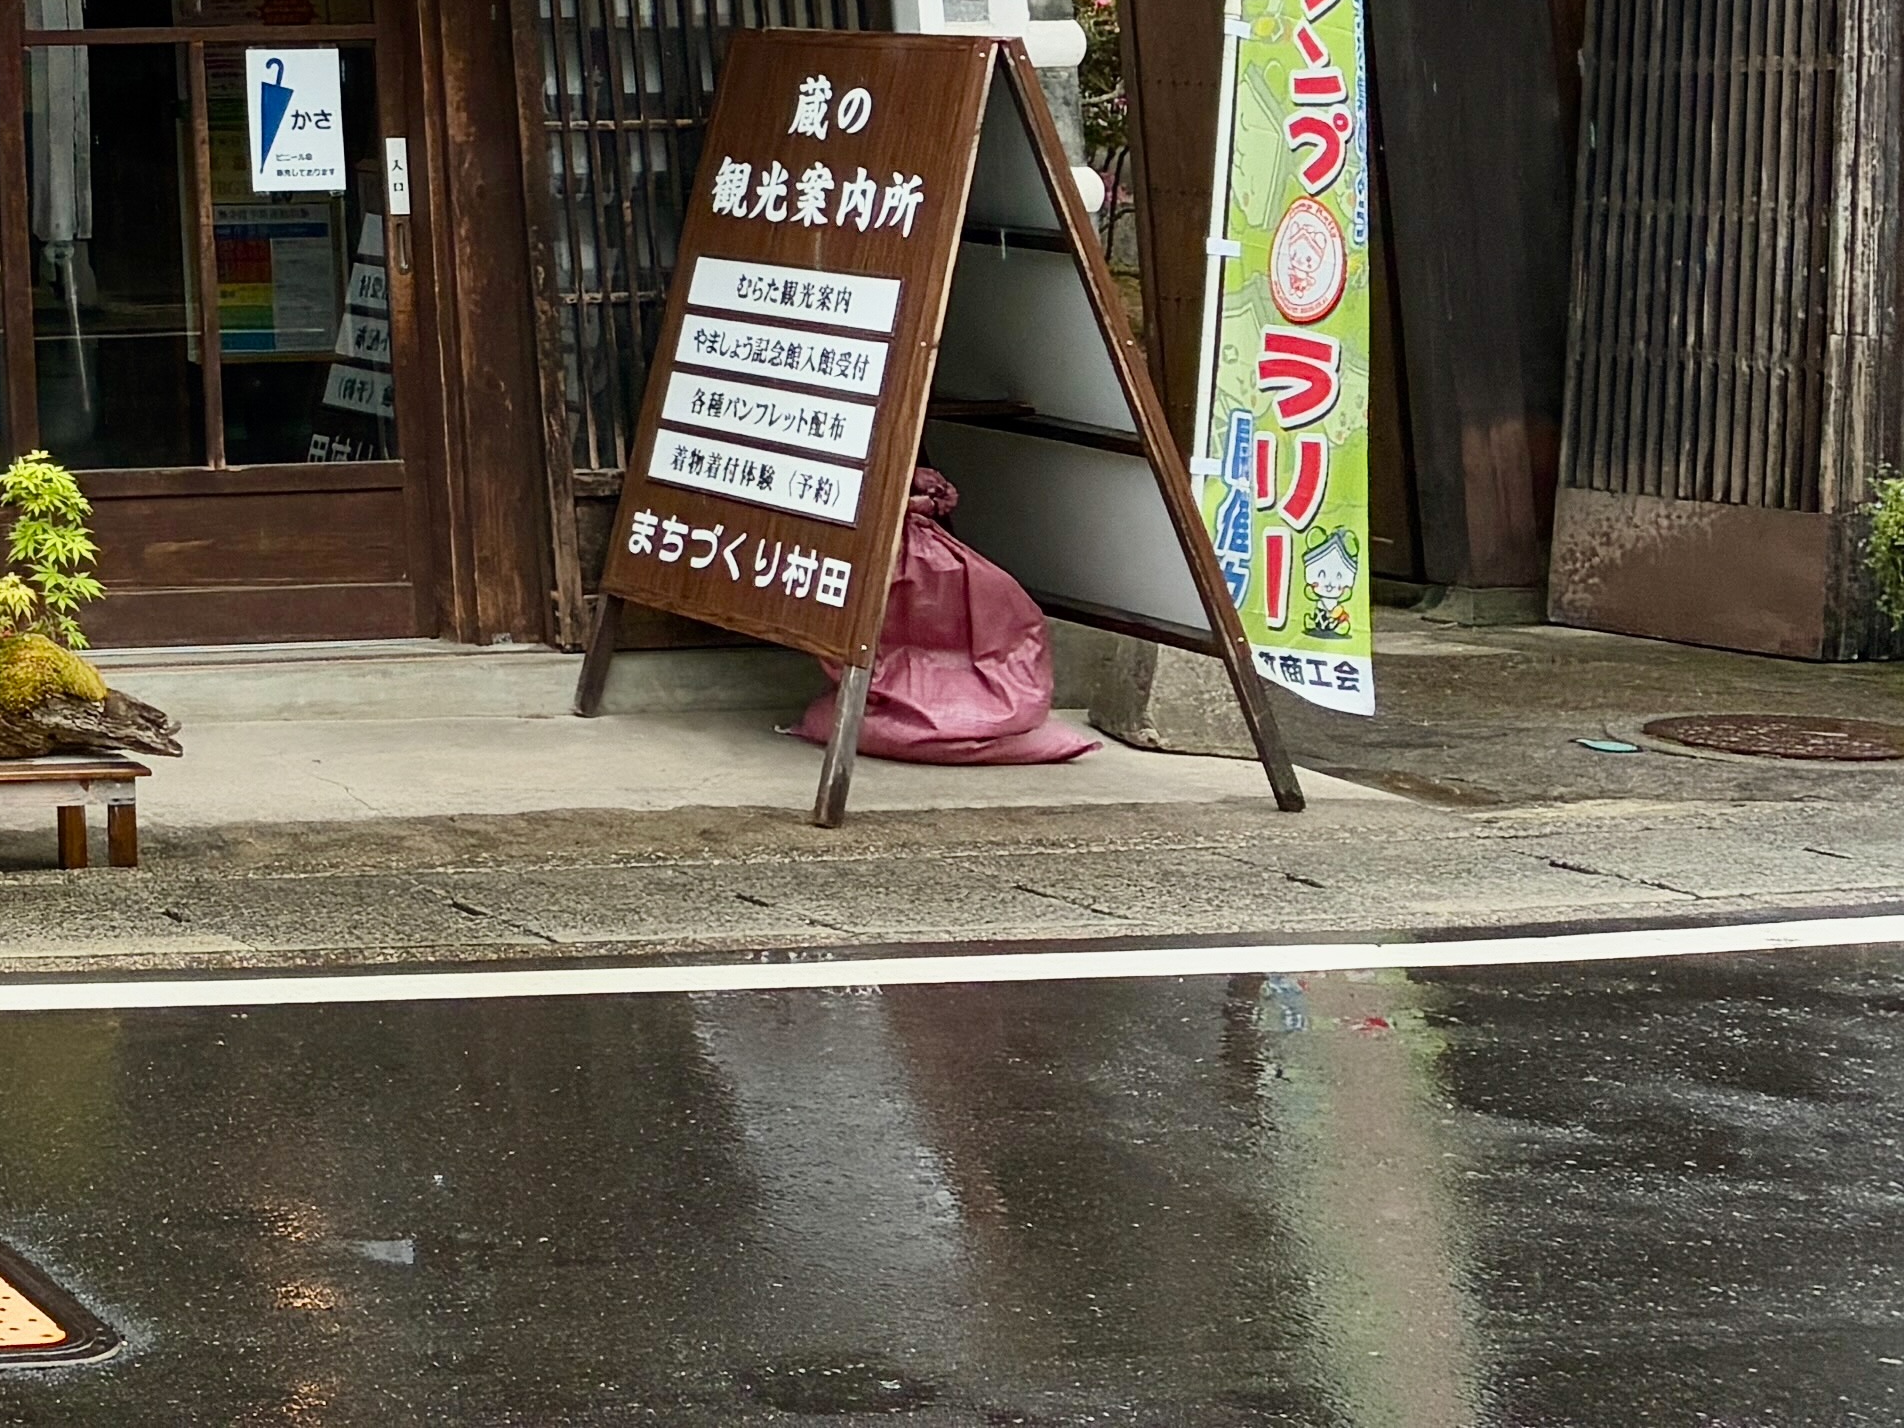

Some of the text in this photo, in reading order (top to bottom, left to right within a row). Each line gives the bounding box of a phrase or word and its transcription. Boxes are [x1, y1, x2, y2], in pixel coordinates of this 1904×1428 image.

[290, 109, 332, 131] かさ
[788, 75, 873, 140] 蔵の
[393, 158, 404, 191] 入口
[710, 156, 925, 239] 観光案内所
[737, 274, 852, 313] むらた観光案内
[694, 328, 870, 382] やましょう記念館入館受付
[691, 388, 847, 441] 各種パンフレット配布
[670, 445, 776, 492] 着物着付体験
[628, 509, 852, 608] まちづくり村田
